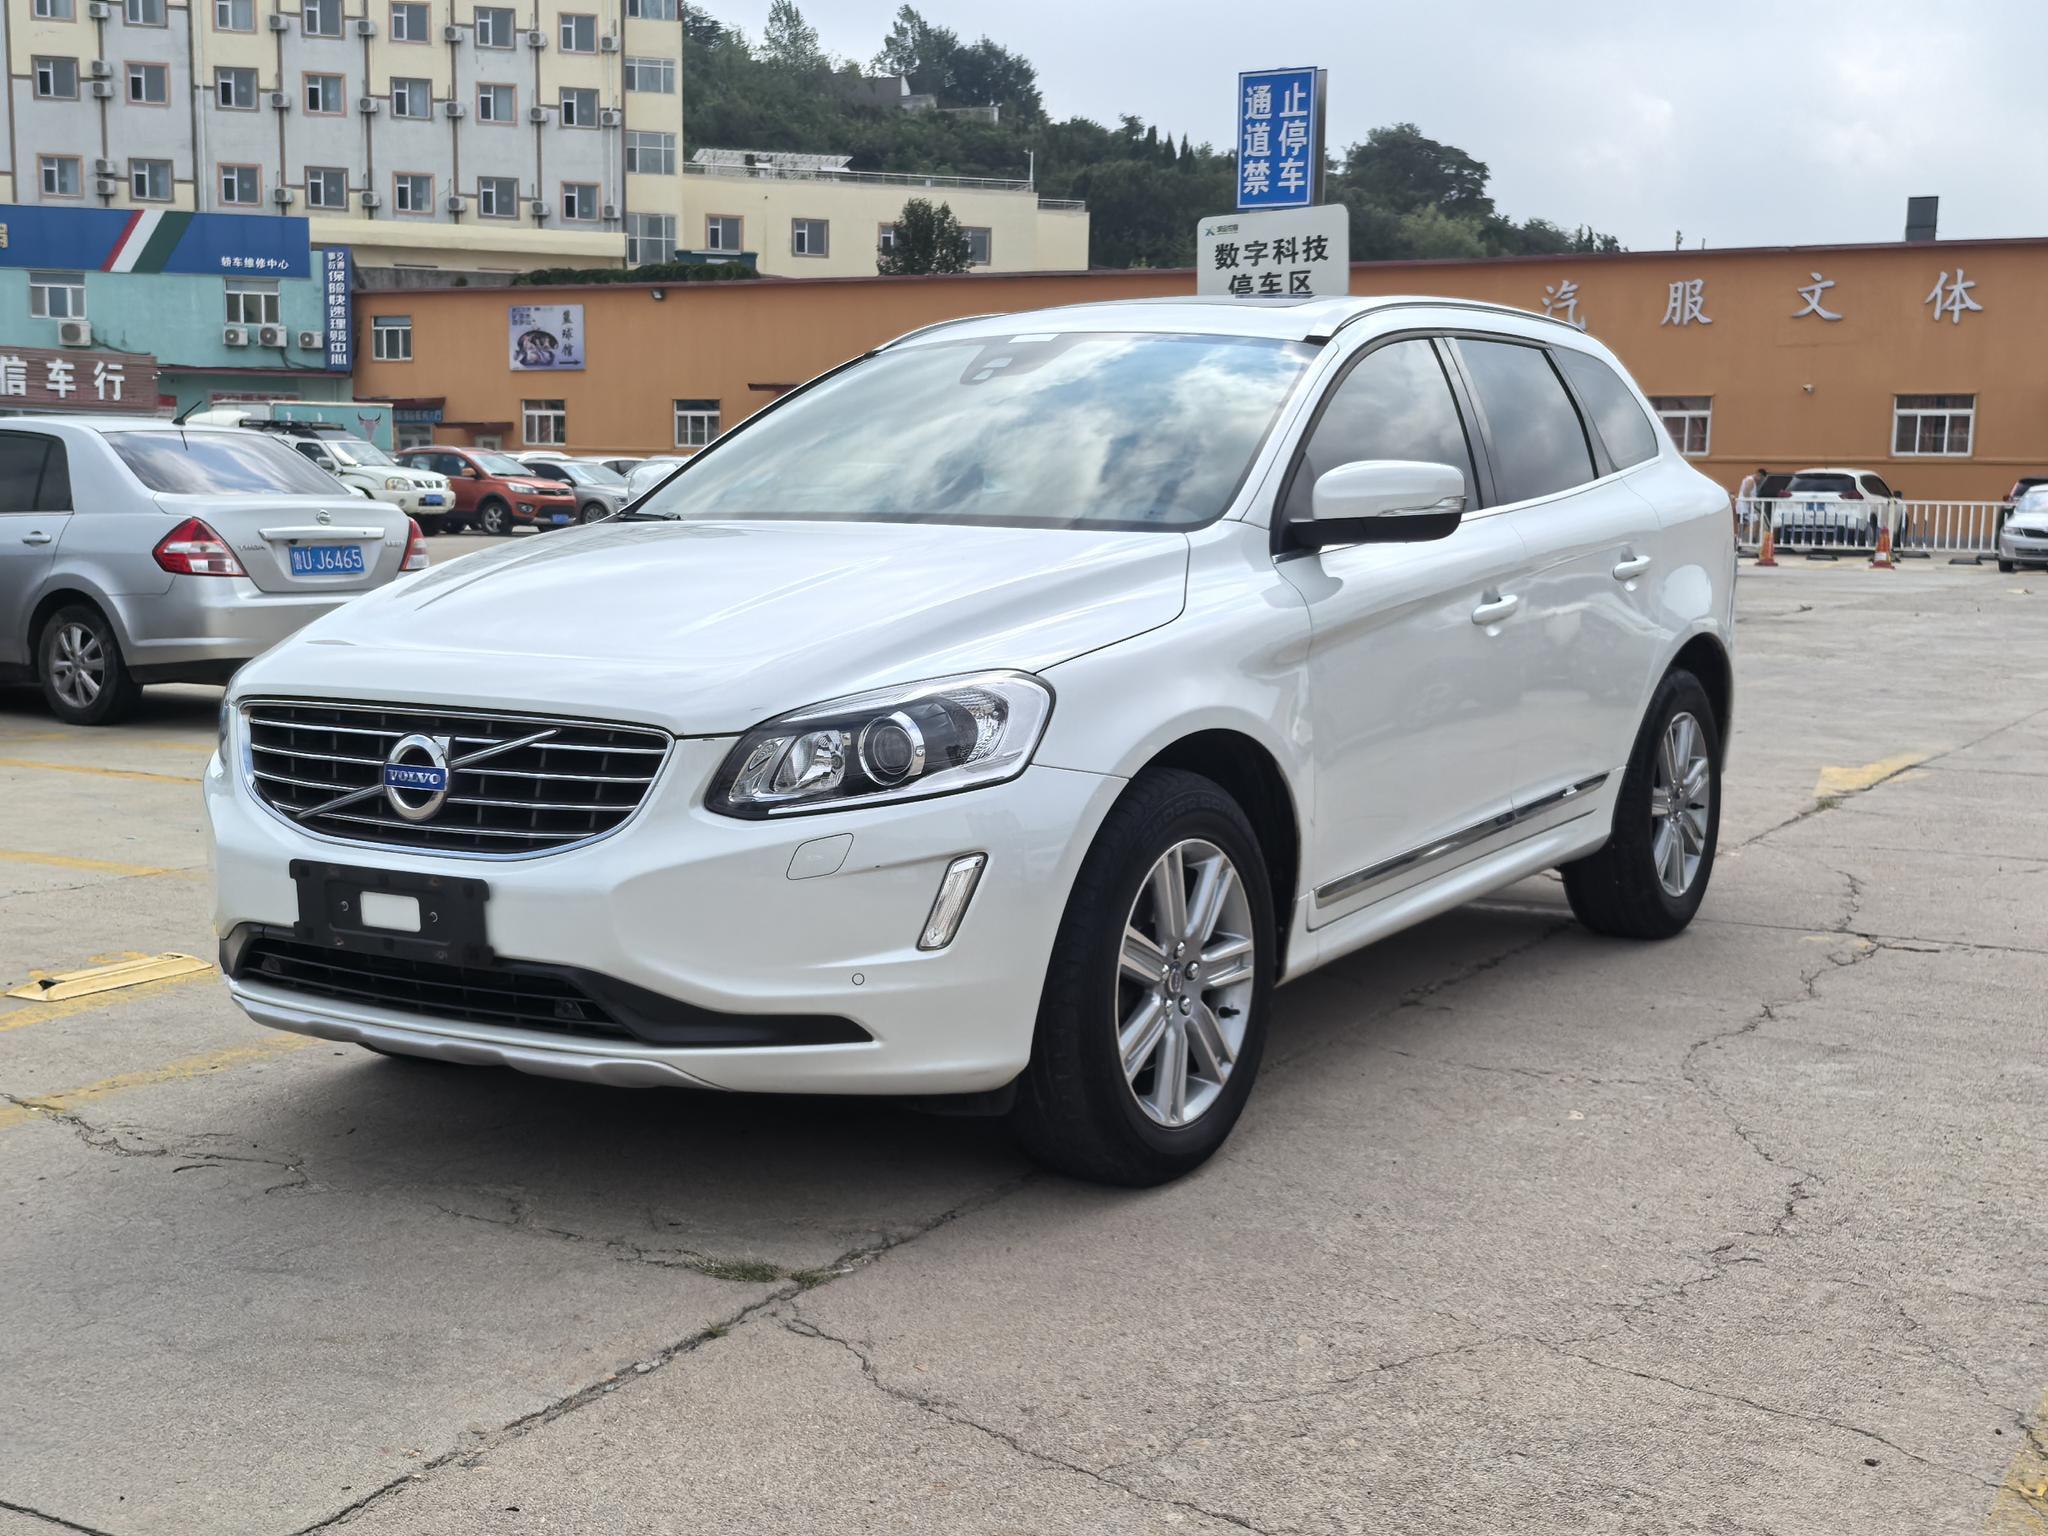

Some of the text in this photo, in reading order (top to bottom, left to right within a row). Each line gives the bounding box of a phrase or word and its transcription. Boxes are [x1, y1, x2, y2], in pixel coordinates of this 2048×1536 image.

[1243, 84, 1273, 196] 通道禁
[1277, 82, 1308, 194] 止停车
[221, 255, 289, 270] 轿车维修中心
[1214, 234, 1329, 270] 数字科技
[1228, 270, 1313, 295] 停车区
[1541, 268, 1984, 331] 汽服文体
[0, 355, 125, 401] 信车行
[387, 768, 441, 785] VOLVO
